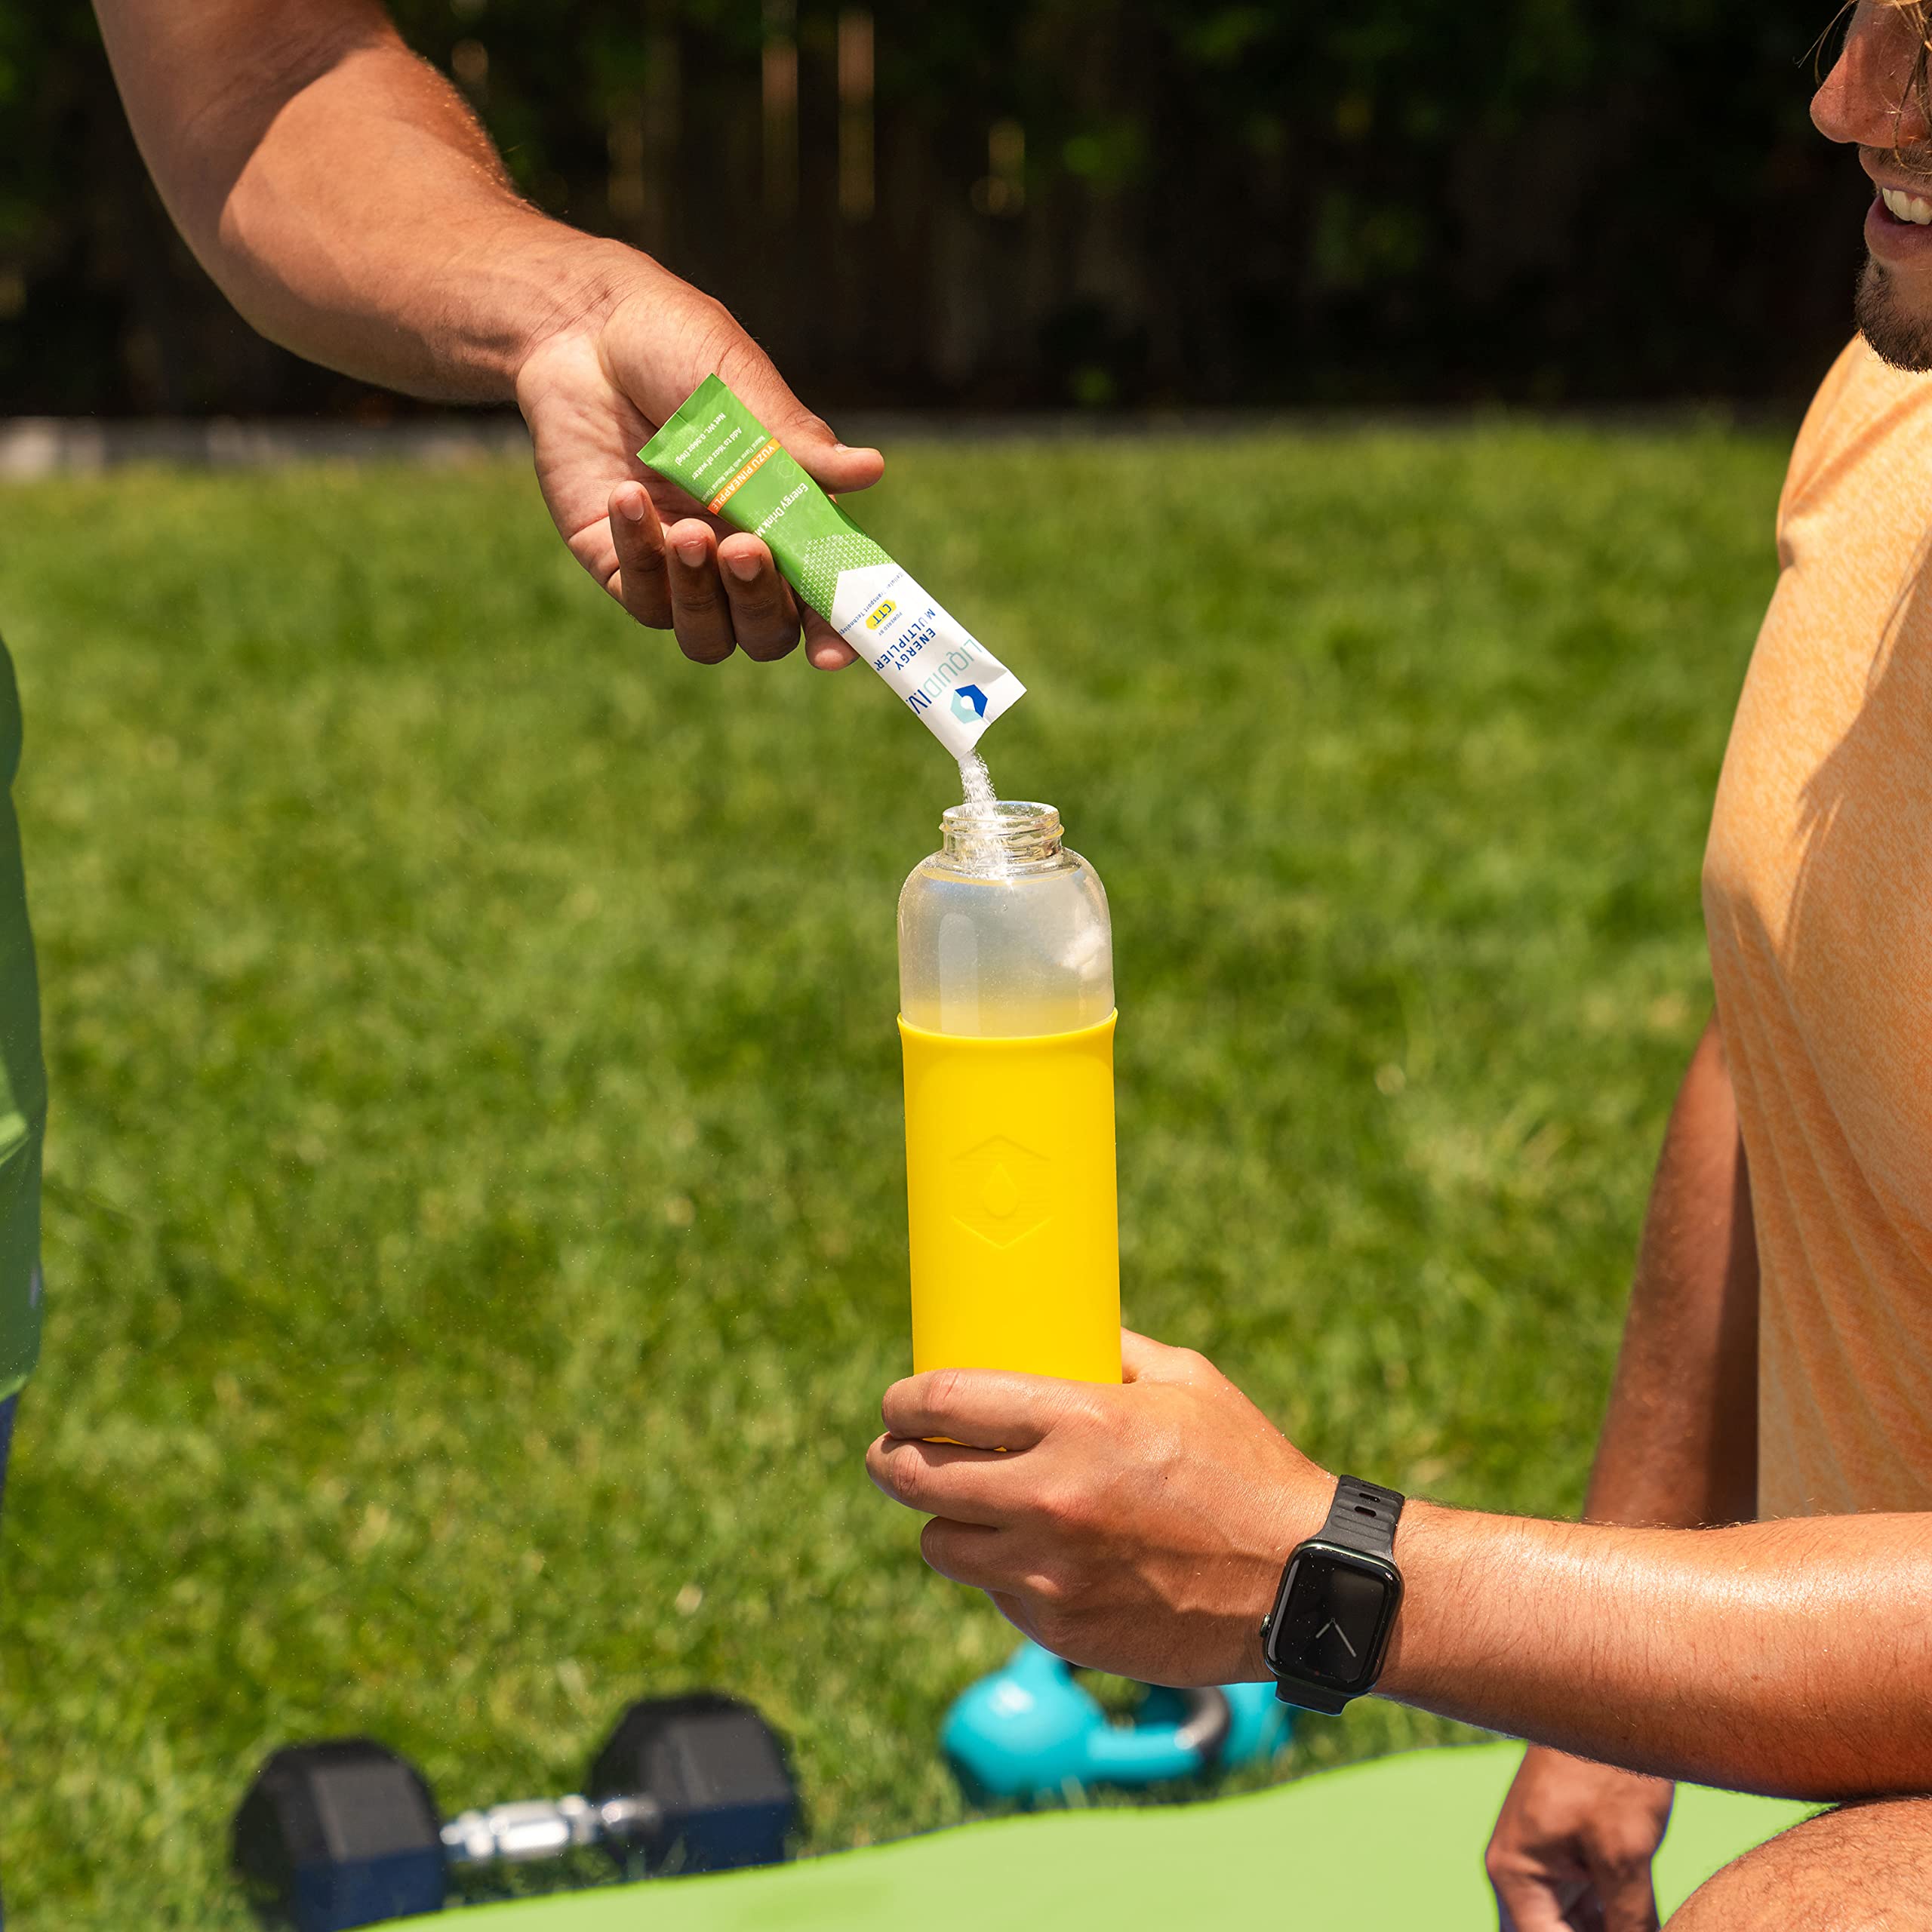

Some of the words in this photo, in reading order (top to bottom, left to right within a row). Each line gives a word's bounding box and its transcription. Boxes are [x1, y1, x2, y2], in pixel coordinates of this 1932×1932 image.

[713, 412, 726, 425] Net
[703, 423, 717, 434] Wt.
[729, 426, 742, 441] Add
[687, 433, 706, 453] 0.56oz
[723, 438, 733, 446] to
[751, 435, 766, 449] Natural
[675, 450, 691, 466] (16g)
[712, 445, 726, 458] 16oz
[740, 447, 754, 460] Flavor
[751, 445, 775, 468] YUZU
[706, 456, 714, 466] of
[733, 458, 743, 468] with
[691, 462, 709, 480] water
[723, 466, 736, 477] Other
[711, 475, 726, 491] Natural
[712, 466, 754, 508] PINEAPPLE
[780, 482, 809, 510] Energy
[761, 506, 785, 529] Drink
[863, 589, 888, 613] Transport
[883, 611, 903, 631] POWERED
[877, 628, 887, 637] BY
[894, 627, 936, 671] ENERGY
[923, 638, 983, 698] LIQUID
